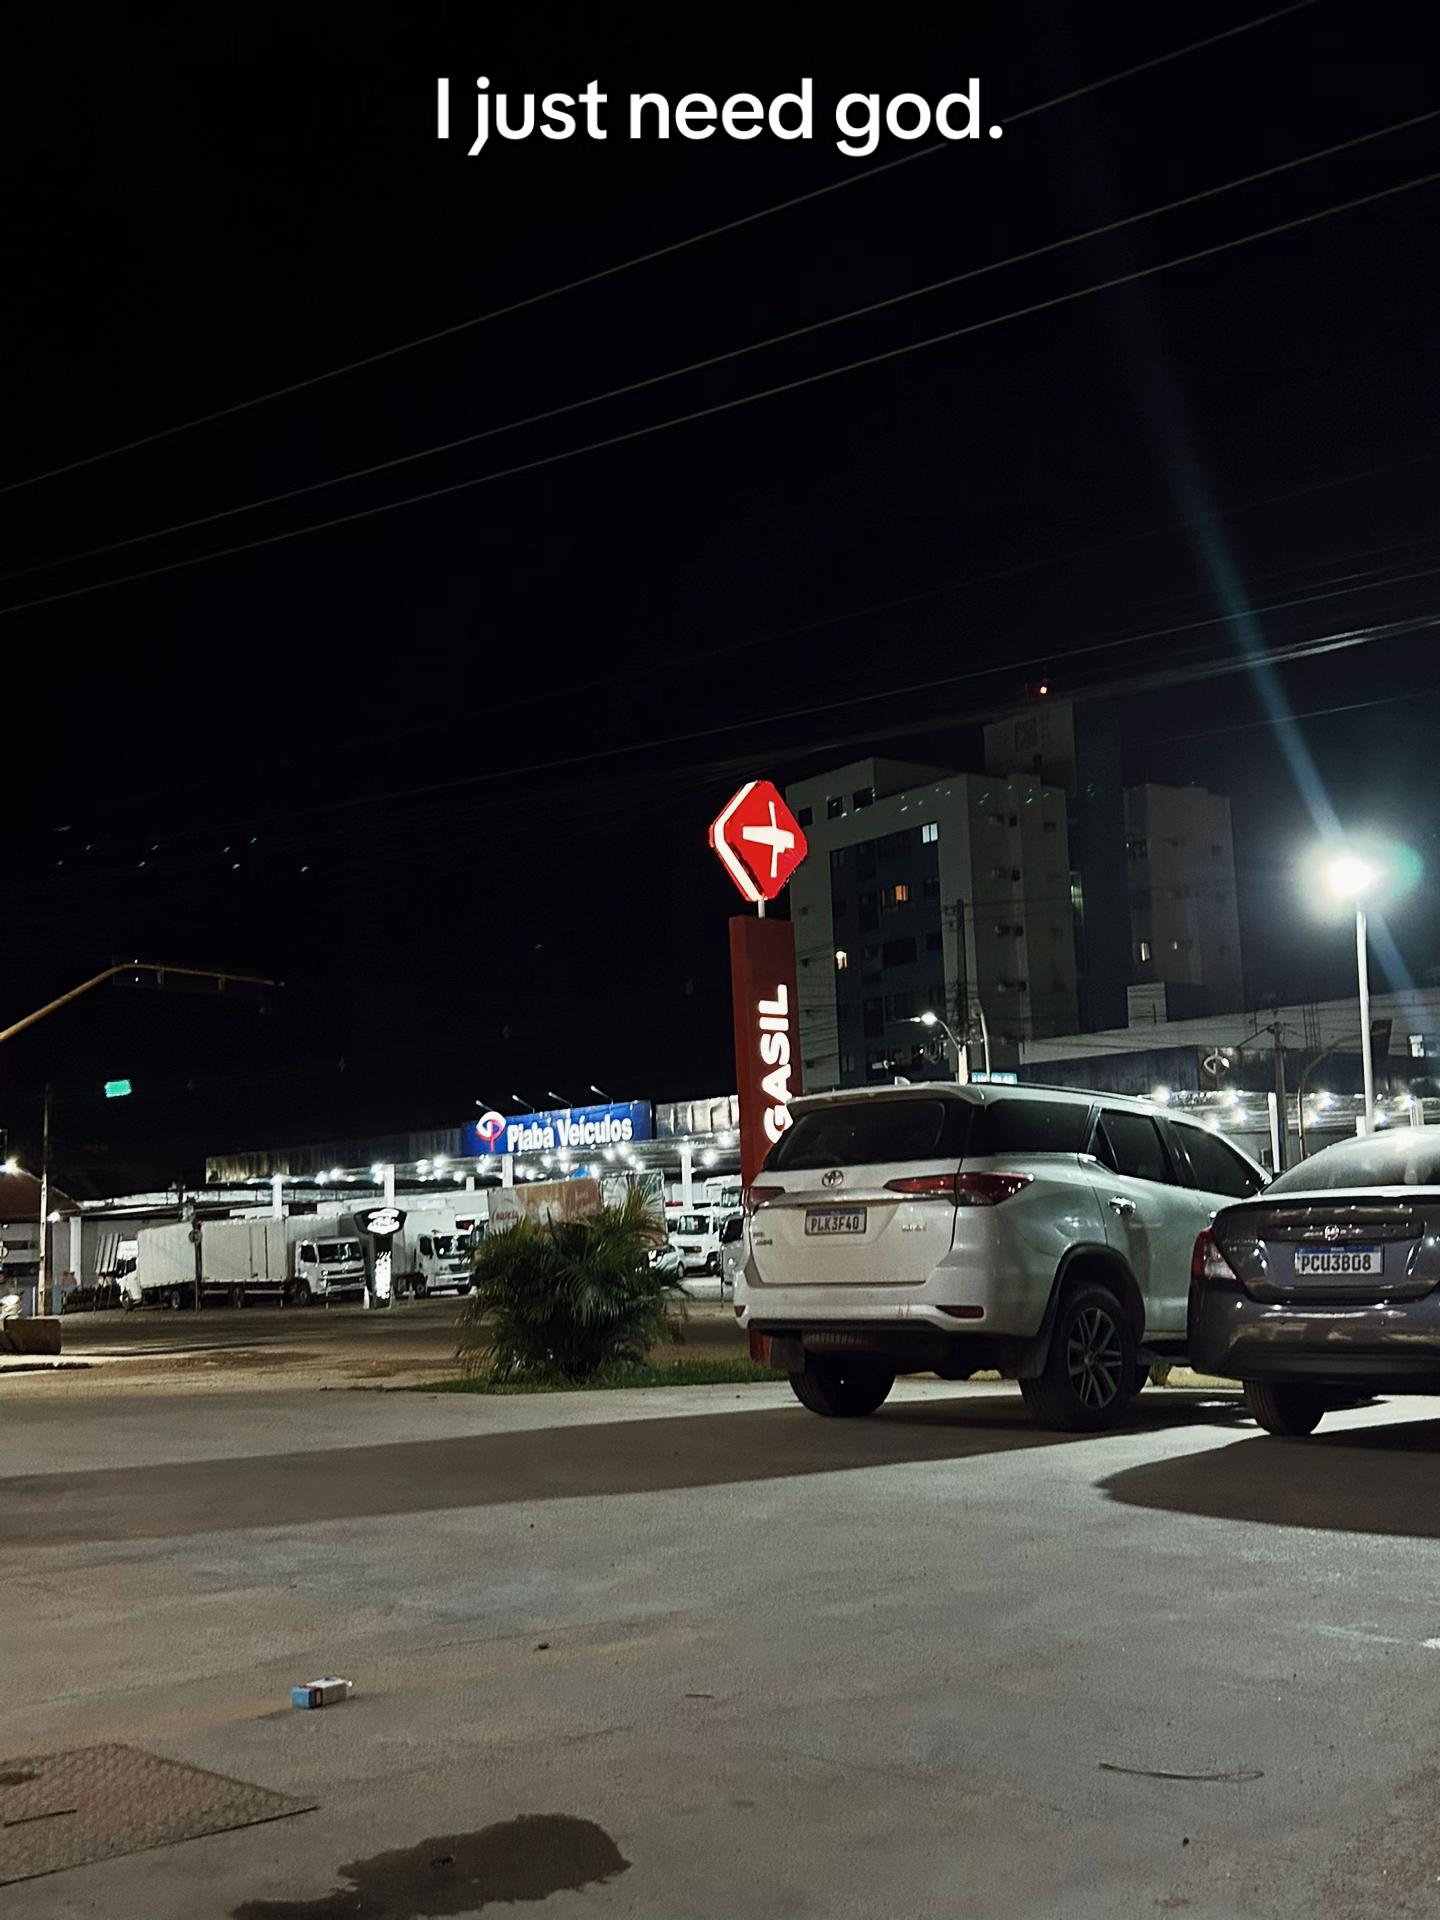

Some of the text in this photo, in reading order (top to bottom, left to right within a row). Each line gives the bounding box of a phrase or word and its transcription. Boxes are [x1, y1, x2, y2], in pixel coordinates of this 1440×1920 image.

[557, 1113, 633, 1147] Veículos
[810, 1215, 860, 1233] PLK3F40
[1301, 1254, 1372, 1272] PCU3B08
